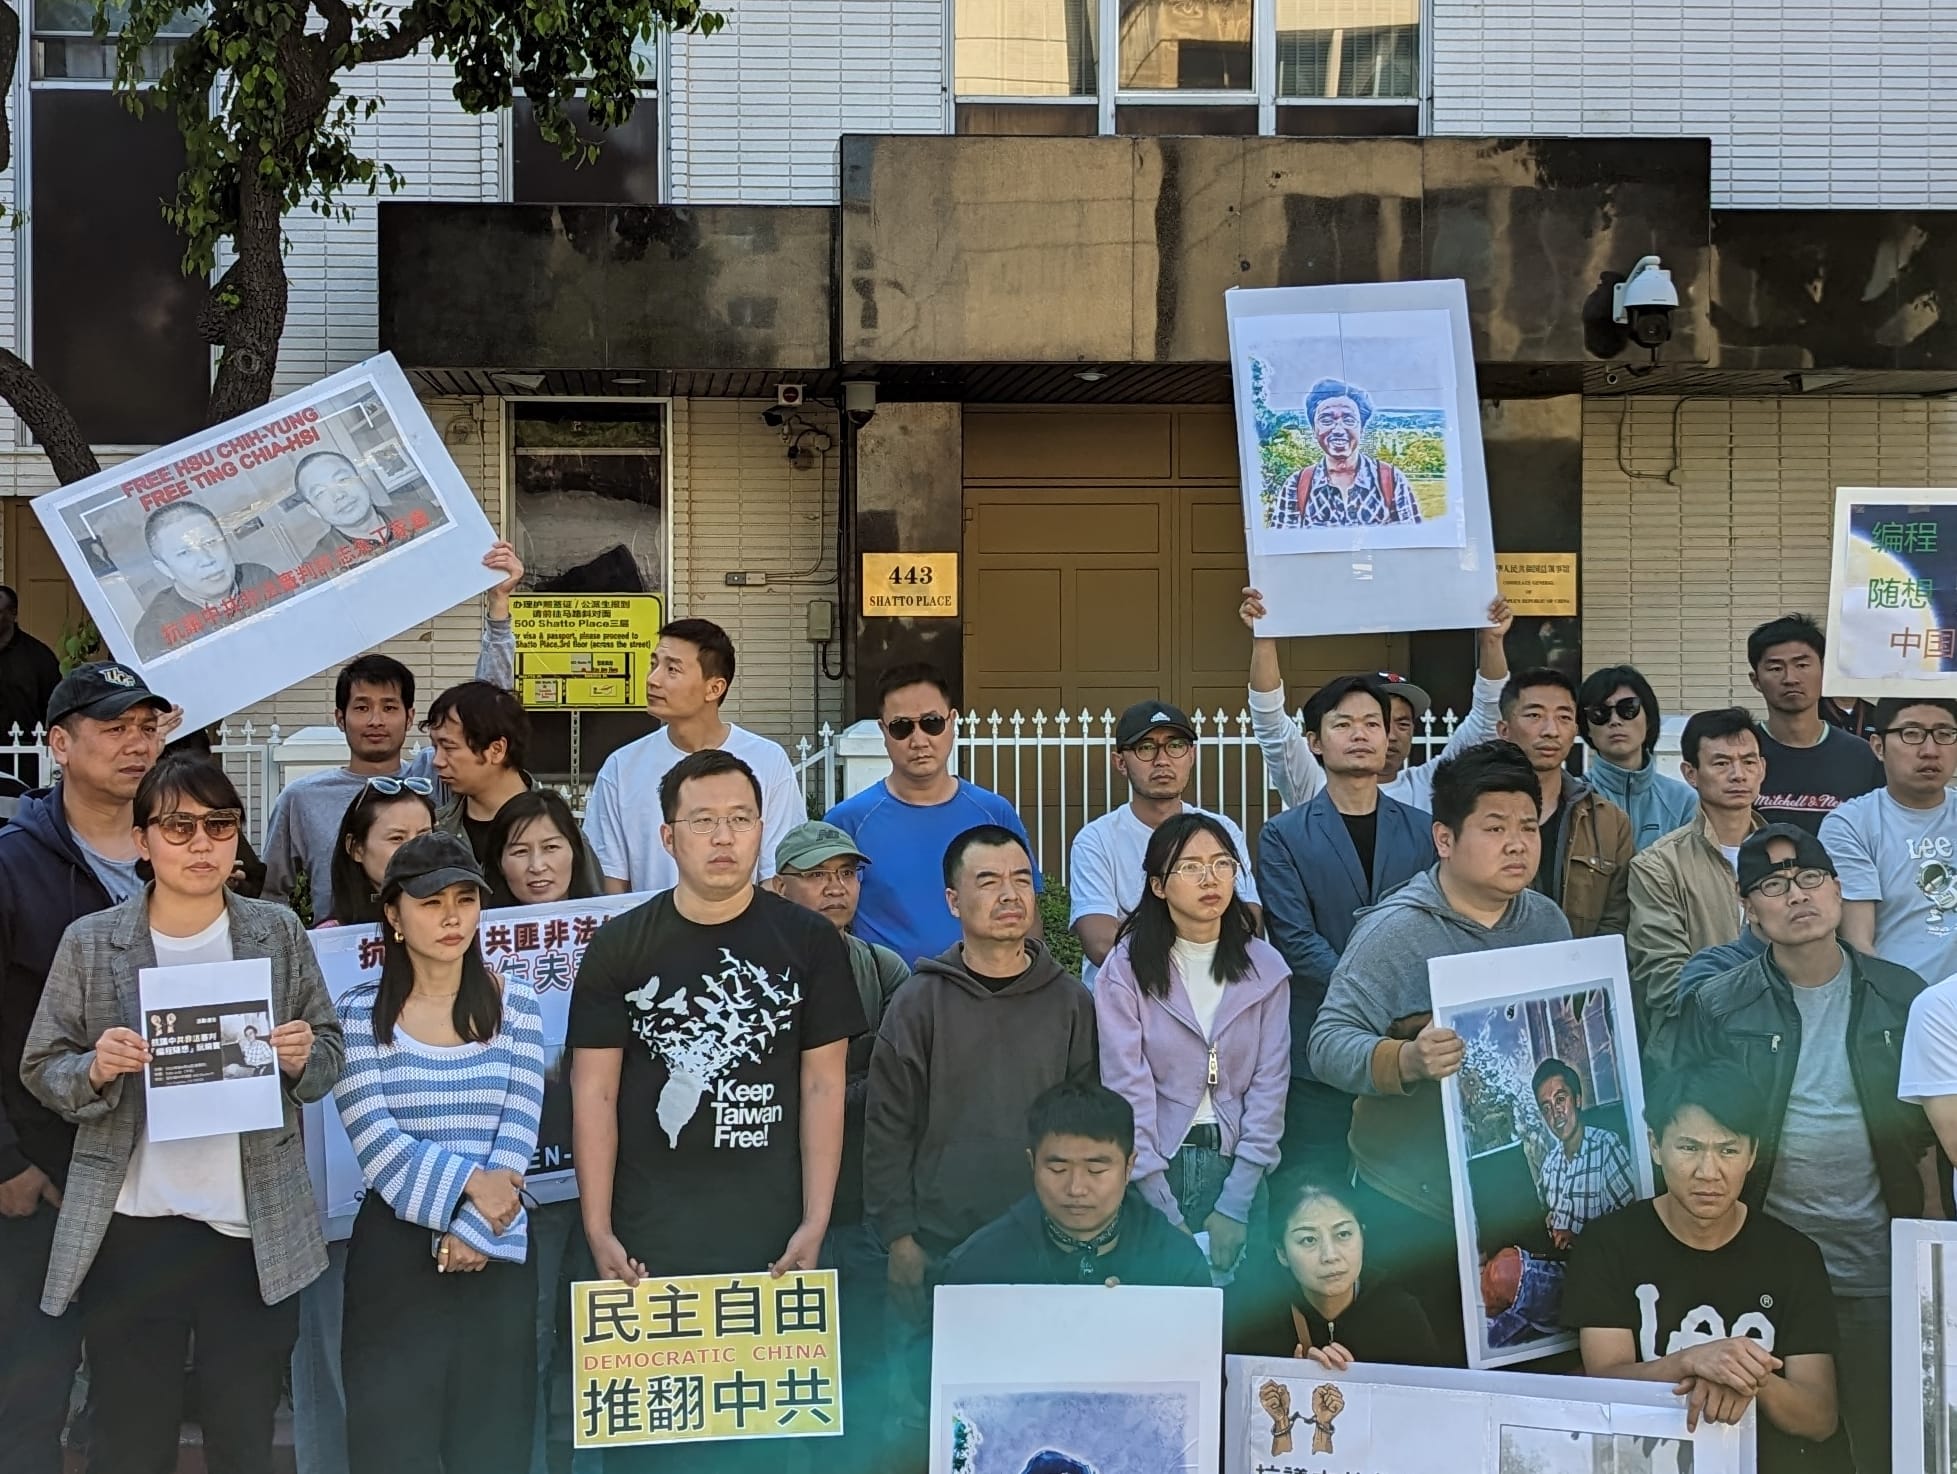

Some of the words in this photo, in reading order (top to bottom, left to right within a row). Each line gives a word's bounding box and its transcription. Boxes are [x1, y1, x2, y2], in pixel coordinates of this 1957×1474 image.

[120, 465, 175, 498] FREE
[173, 452, 215, 478] HSU
[216, 407, 320, 459] CHIH-YUNG
[139, 480, 192, 512] FREE
[191, 461, 238, 489] TING
[239, 426, 320, 470] CHIA-HSI
[1871, 521, 1938, 553] 编程
[889, 566, 933, 584] 443
[869, 595, 914, 607] SHATTO
[916, 595, 952, 607] PLACE
[1867, 578, 1933, 610] 随想
[514, 619, 536, 628] 500
[538, 619, 575, 628] Shatto
[1890, 627, 1955, 659] 中国
[1754, 793, 1807, 807] Mitchell
[1807, 796, 1818, 807] &
[1819, 794, 1843, 808] Ne
[1906, 836, 1953, 860] Lee
[717, 1078, 775, 1106] Keep
[710, 1102, 783, 1125] Taiwan
[714, 1124, 769, 1148] Free!
[582, 1276, 828, 1344] 民主自由
[583, 1347, 736, 1371] DEMOCRATIC
[752, 1343, 827, 1361] CHINA
[582, 1367, 833, 1437] 推翻中共
